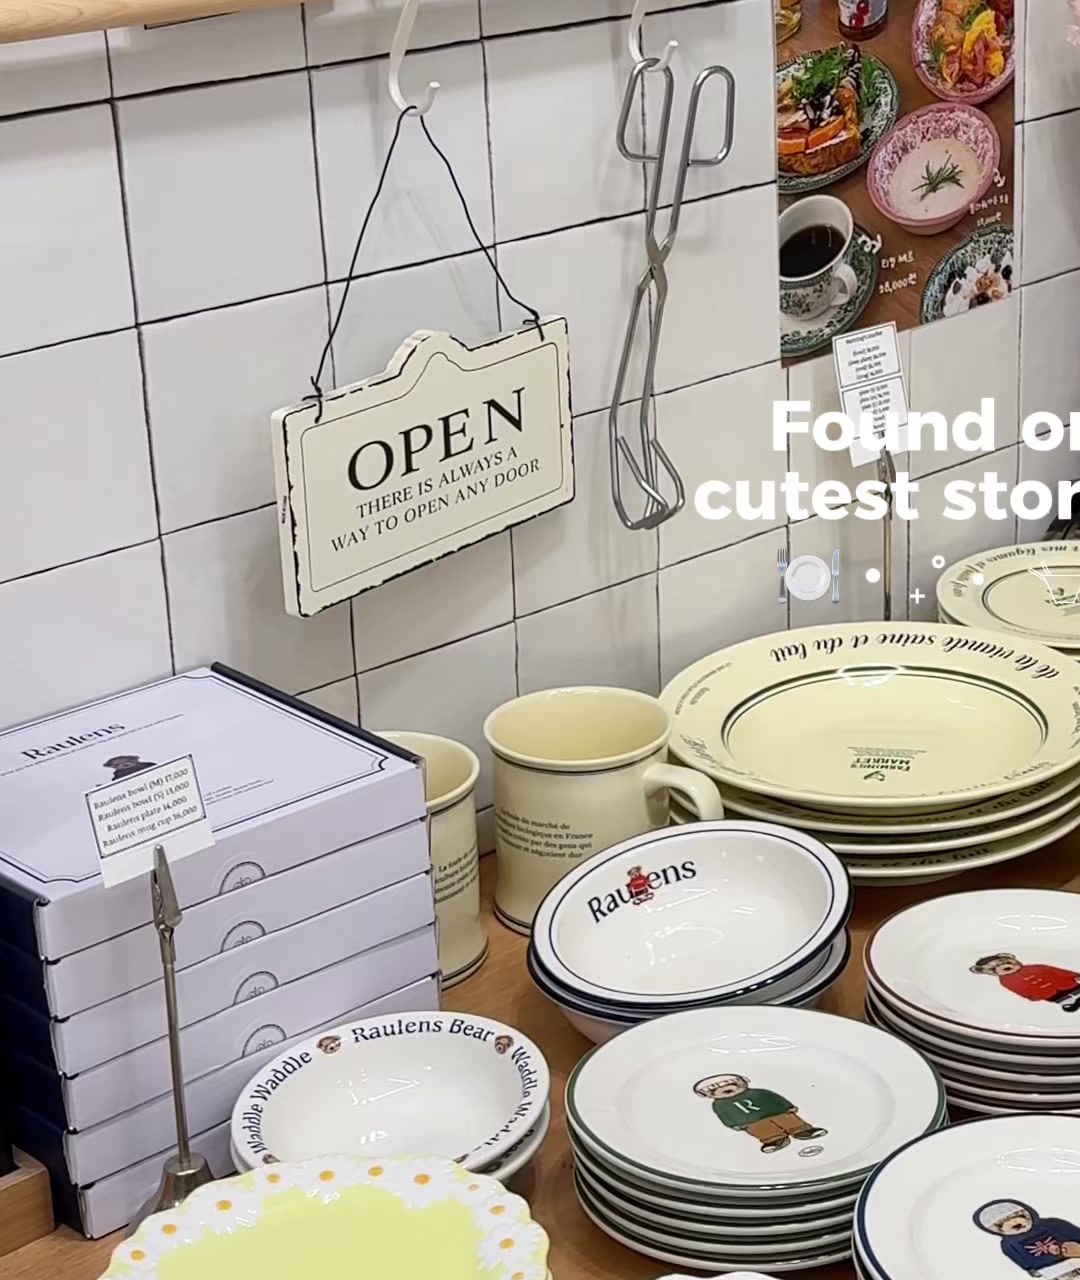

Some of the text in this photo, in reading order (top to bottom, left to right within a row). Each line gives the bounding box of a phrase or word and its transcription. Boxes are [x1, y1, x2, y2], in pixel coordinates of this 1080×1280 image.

[347, 387, 526, 492] OPEN
[355, 446, 519, 519] THERE IS ALWAYS A
[330, 524, 370, 553] WAY
[374, 515, 399, 535] TO
[403, 494, 450, 524] OPEN
[455, 477, 489, 504] ANY
[769, 644, 808, 664] lait
[813, 637, 843, 656] du
[851, 634, 869, 650] et
[876, 634, 937, 650] saine
[942, 635, 1010, 661] viande
[21, 723, 126, 760] Raulens
[852, 757, 911, 765] MARKET
[93, 792, 127, 810] Raulens
[127, 783, 148, 797] bowl
[98, 805, 131, 822] Raulens
[132, 796, 153, 810] bowl
[107, 816, 140, 832] Raulens
[140, 806, 161, 821] plate
[102, 831, 136, 848] Raulens
[137, 823, 157, 836] mug
[587, 860, 697, 924] Rauens
[352, 1018, 495, 1044] Raulens Bear
[242, 1050, 314, 1155] Waddle Waddle
[733, 1098, 760, 1115] R
